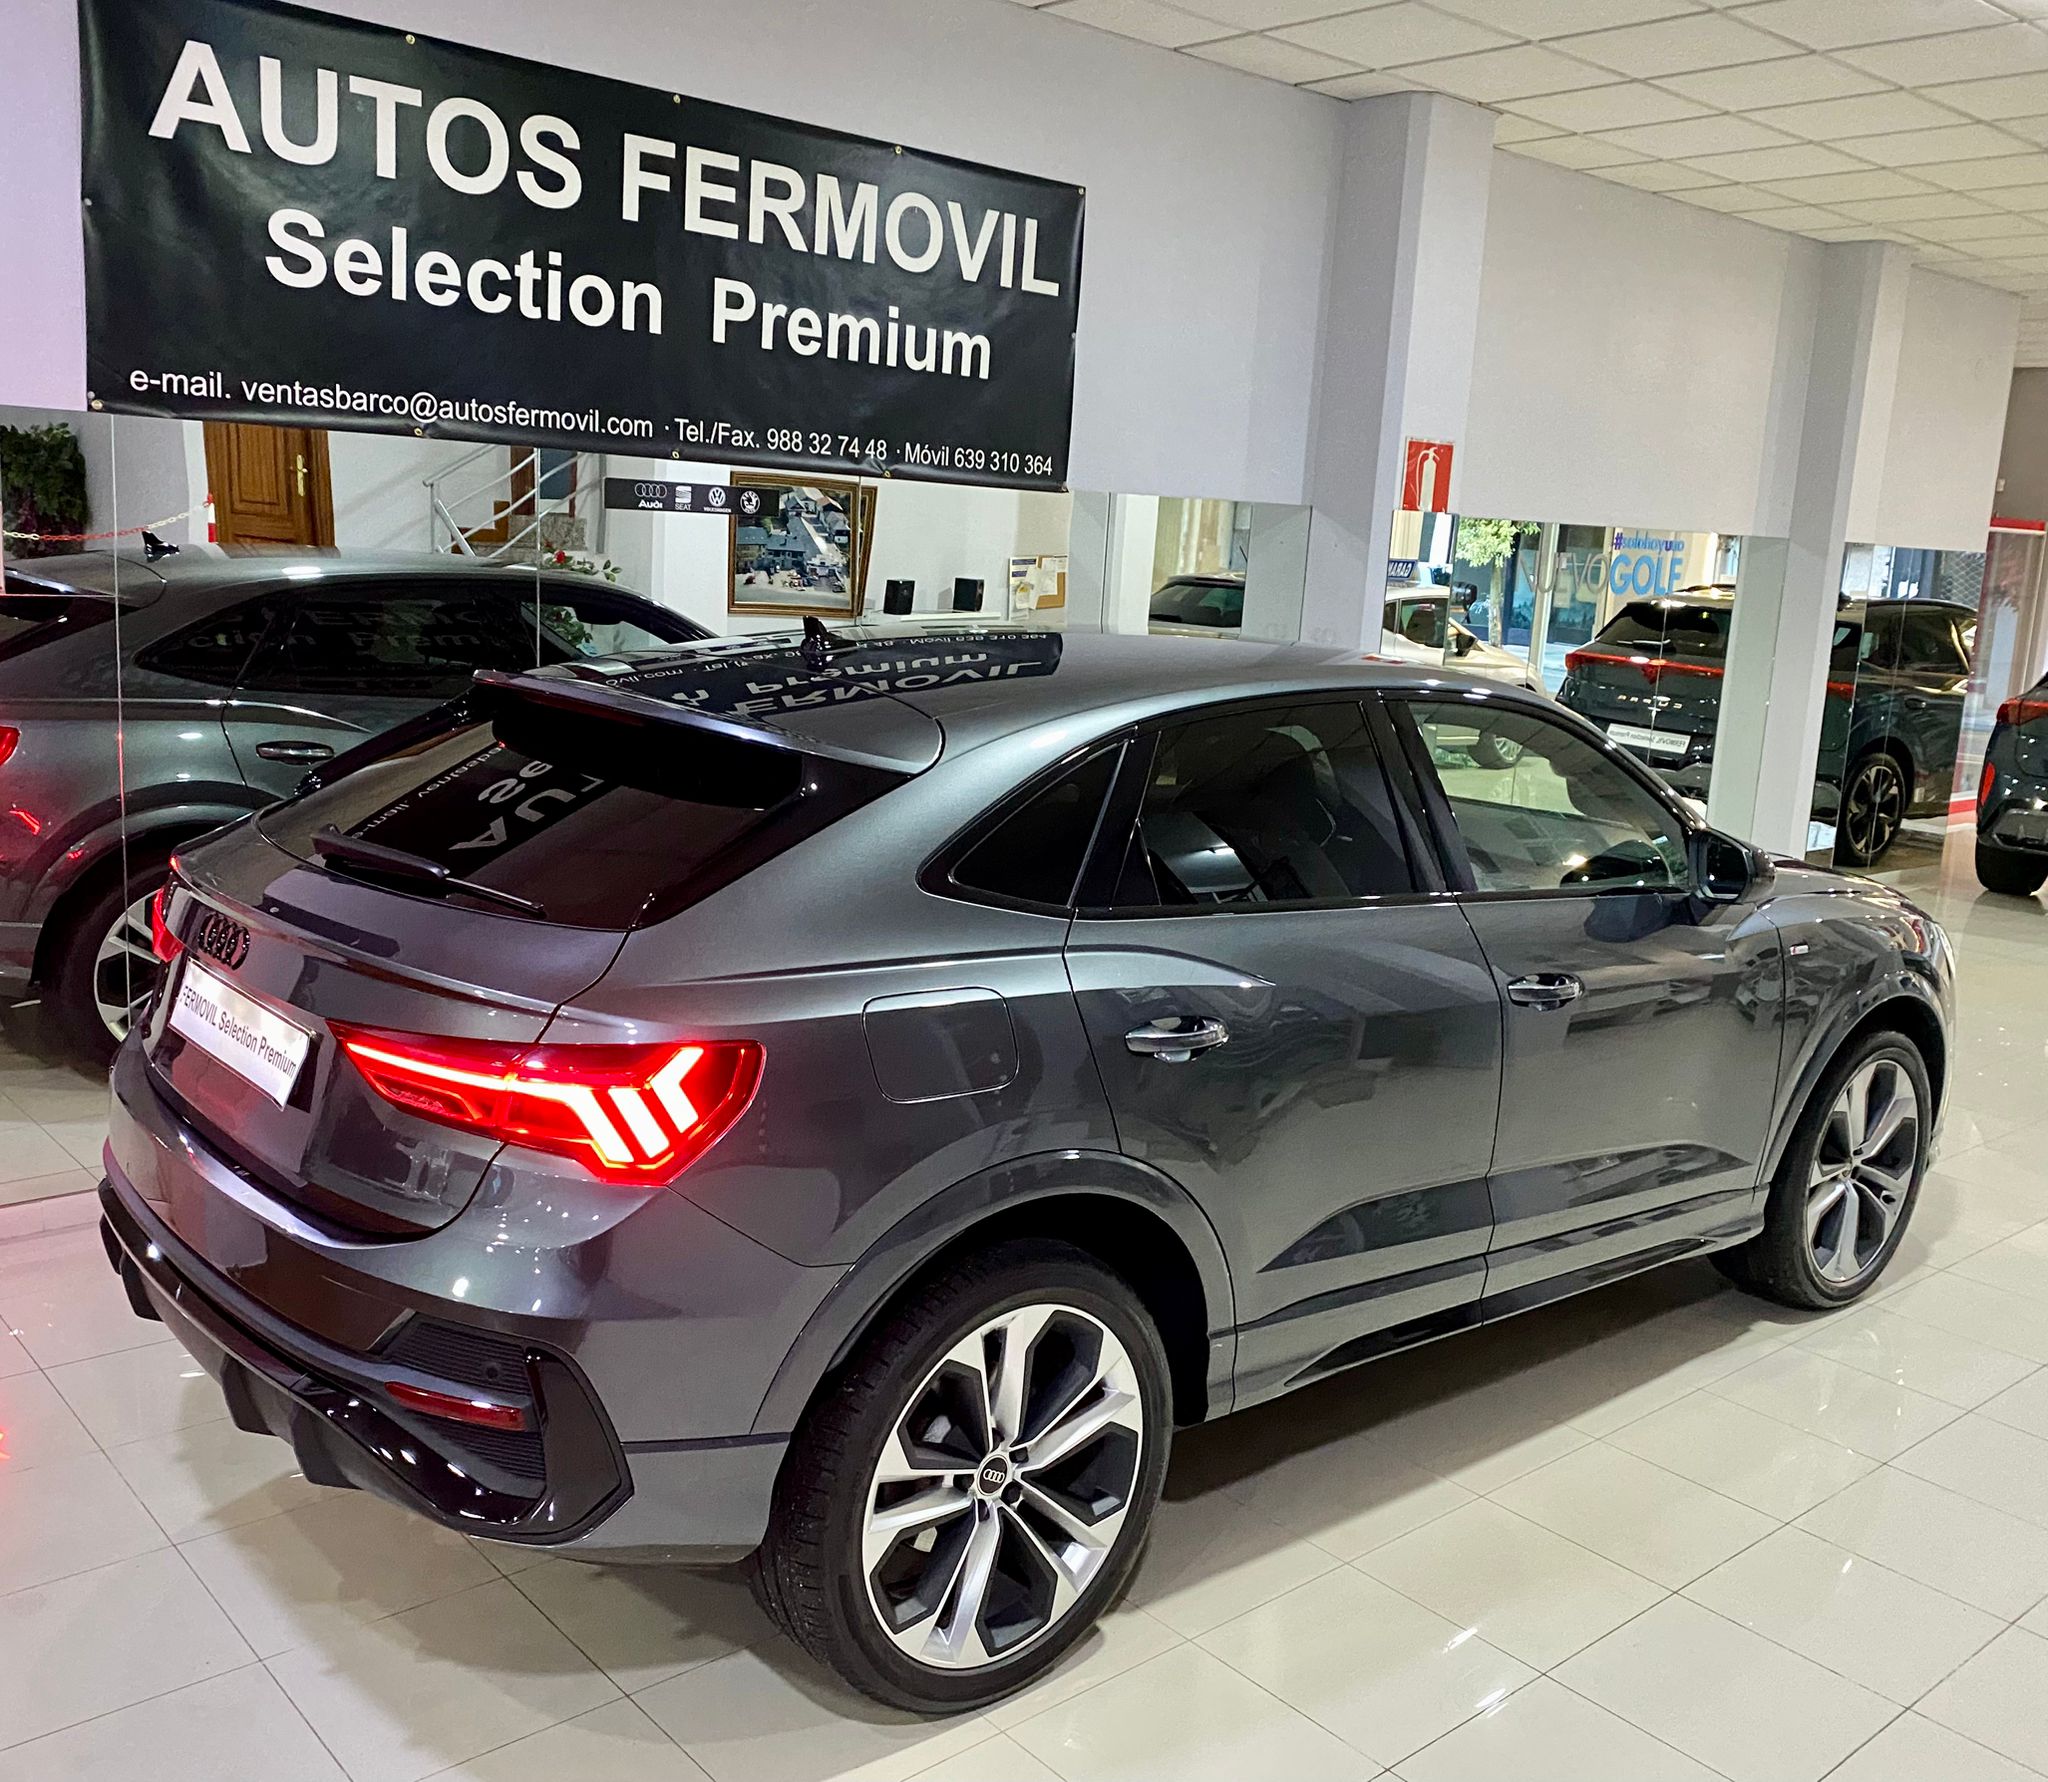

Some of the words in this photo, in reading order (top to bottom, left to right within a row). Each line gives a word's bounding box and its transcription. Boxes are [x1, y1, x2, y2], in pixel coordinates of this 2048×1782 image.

[149, 40, 582, 209] AUTOS
[623, 133, 1060, 297] FERMOVIL
[265, 208, 662, 335] Selection
[712, 277, 992, 380] Premium
[129, 369, 232, 399] e-mail.
[241, 380, 654, 439] ventasbarco@autosfermovil.com
[674, 417, 761, 450] Tel./Fax.
[766, 427, 804, 454] 988
[808, 433, 832, 456] 32
[837, 436, 861, 459] 74
[864, 439, 888, 462] 48
[904, 441, 951, 467] Móvil
[953, 448, 986, 471] 639
[989, 450, 1021, 474] 310
[1024, 454, 1054, 477] 364
[637, 499, 664, 509] Audi
[674, 502, 692, 511] SEAT
[1518, 551, 1611, 595] NUEVO
[1608, 553, 1684, 597] GOLF
[181, 985, 218, 1027] FERMOVIL
[218, 1010, 258, 1055] Selection
[257, 1036, 297, 1080] Premium
